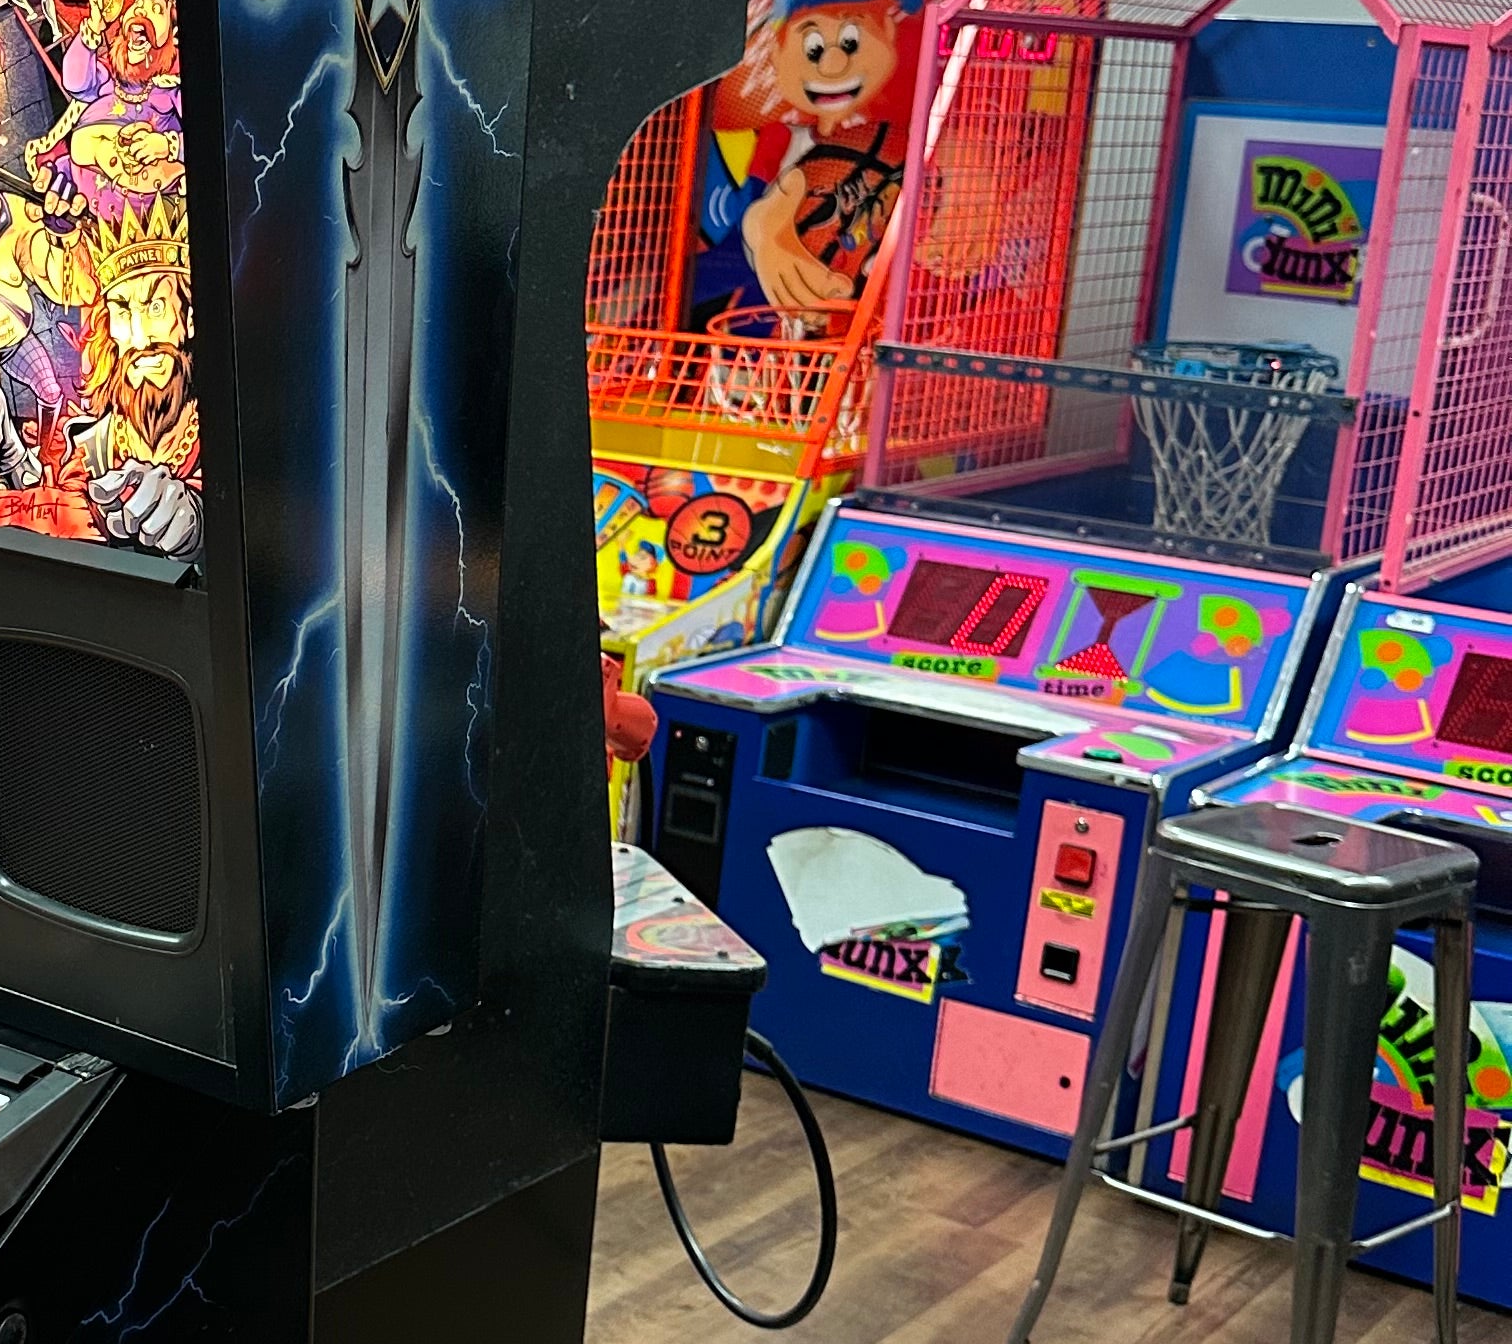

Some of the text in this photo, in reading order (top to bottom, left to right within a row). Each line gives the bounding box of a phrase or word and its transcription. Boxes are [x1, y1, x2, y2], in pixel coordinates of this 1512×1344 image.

[119, 249, 158, 269] PAYNE
[691, 509, 730, 546] 3
[902, 654, 983, 676] score
[1043, 679, 1105, 699] time
[1457, 763, 1512, 787] sco
